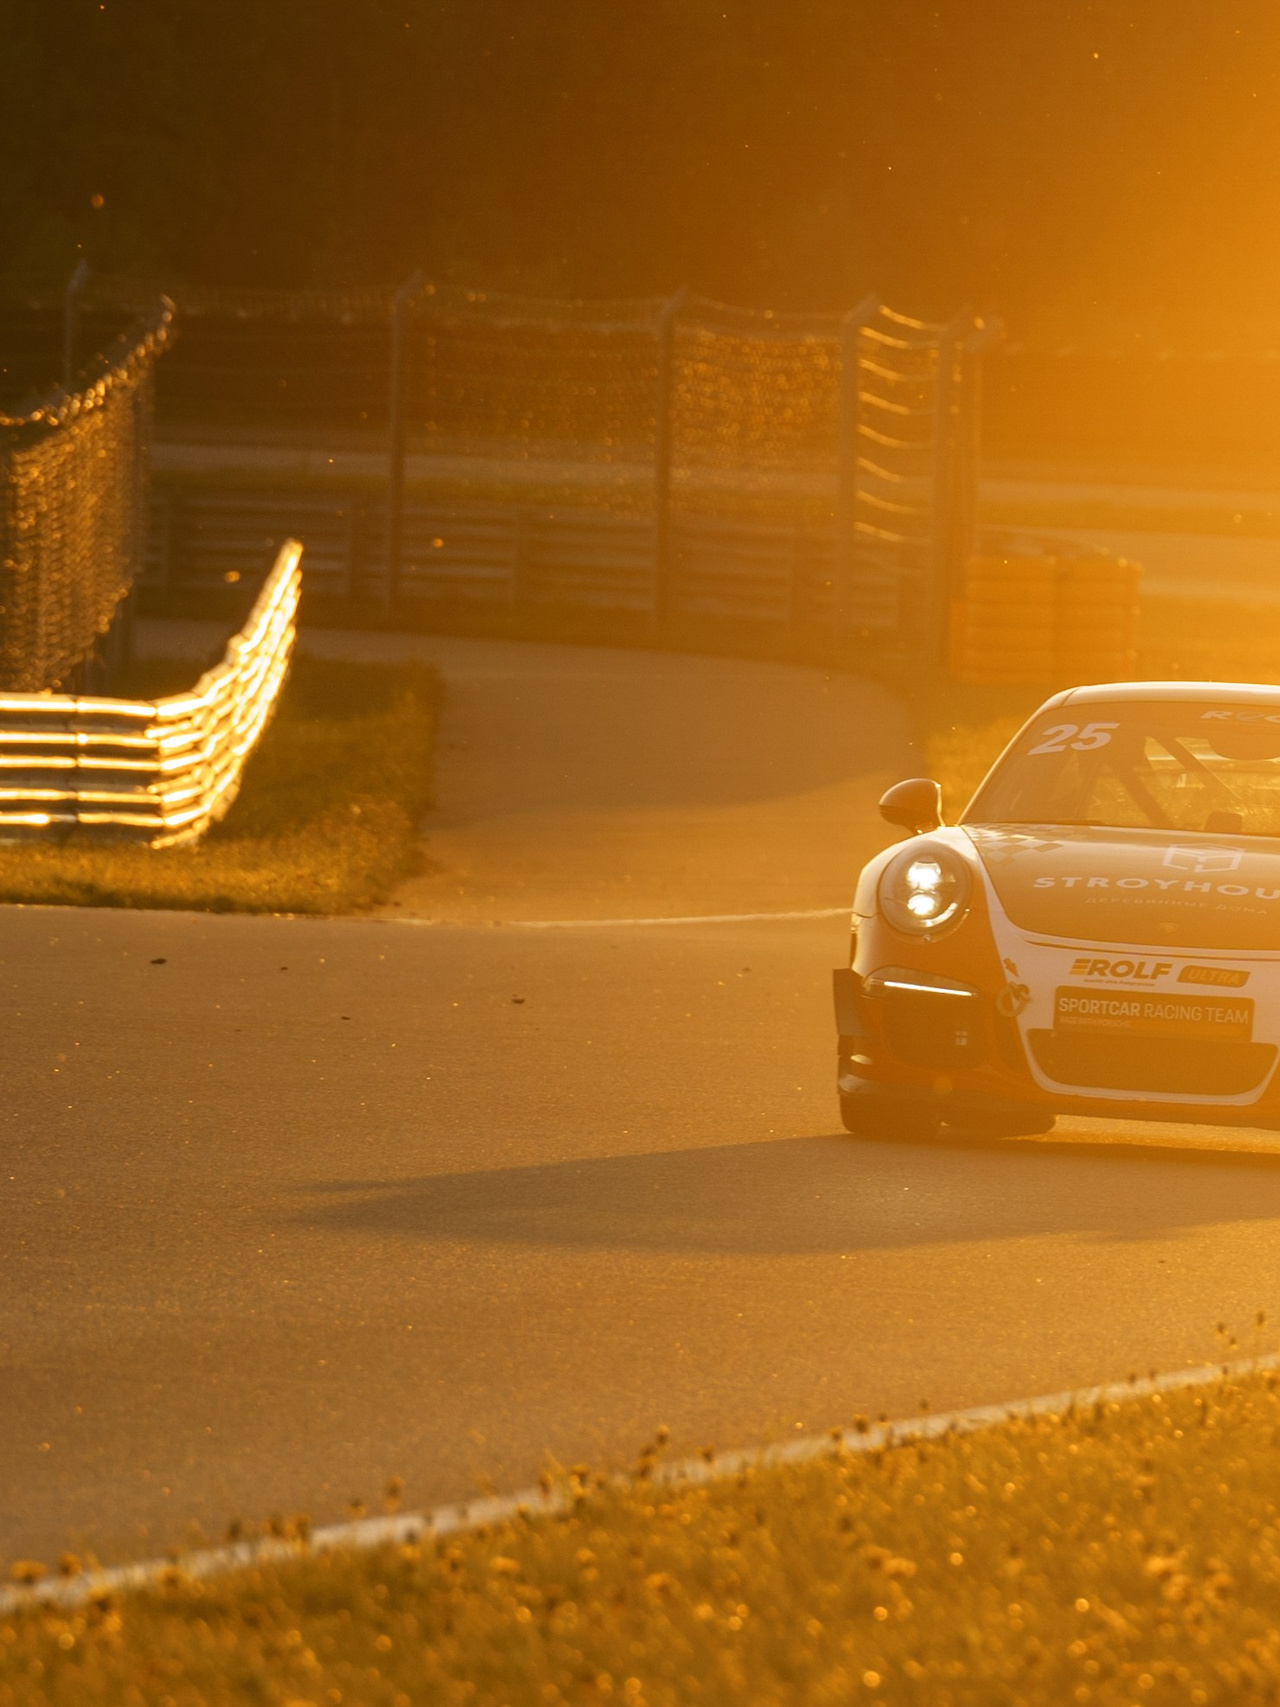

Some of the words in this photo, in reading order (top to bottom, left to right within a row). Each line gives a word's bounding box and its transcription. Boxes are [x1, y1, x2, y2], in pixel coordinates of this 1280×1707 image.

[1027, 722, 1120, 755] 25
[1086, 959, 1173, 980] ROLF
[1187, 969, 1241, 984] ULTRA
[1059, 997, 1140, 1017] SPORTCAR
[1144, 1003, 1203, 1021] RACING
[1206, 1007, 1249, 1025] TEAM
